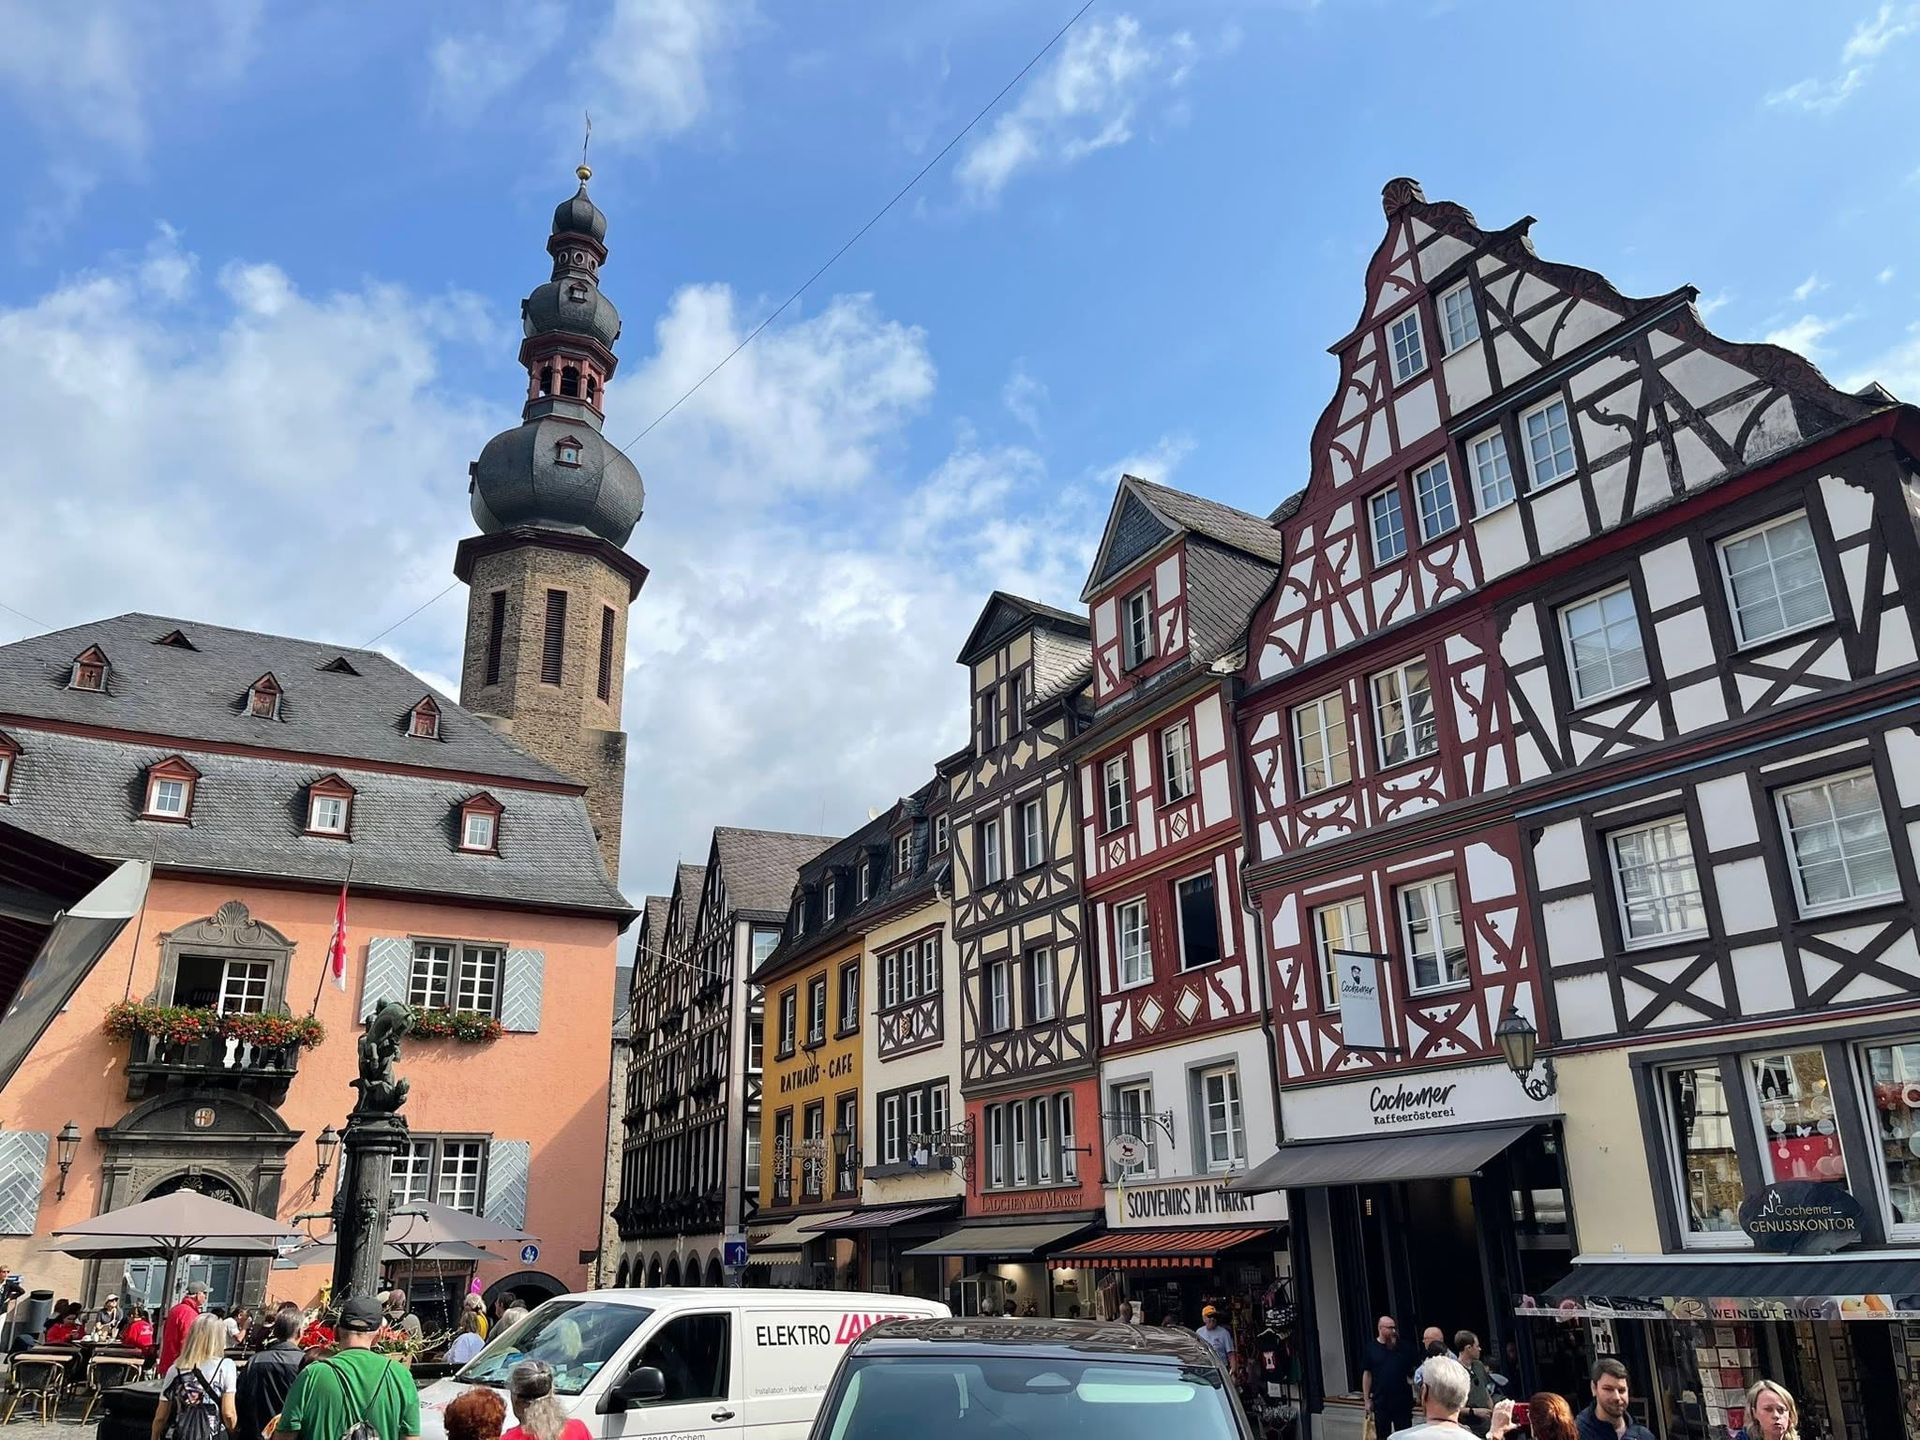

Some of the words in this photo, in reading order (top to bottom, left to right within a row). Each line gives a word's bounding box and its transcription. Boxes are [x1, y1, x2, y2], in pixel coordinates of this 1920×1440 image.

[1341, 980, 1375, 996] Cochemer
[780, 1064, 820, 1093] RATHAUS
[829, 1053, 852, 1079] CAFE
[1369, 1083, 1457, 1112] Cochemer
[1373, 1106, 1456, 1125] Kaffeerösterei
[1044, 1191, 1083, 1209] MARKT
[1127, 1187, 1191, 1219] SOUVENIRS
[1195, 1185, 1212, 1214] AM
[1775, 1203, 1832, 1216] Cochemer
[1749, 1217, 1856, 1233] GENUSSKONTOR
[1711, 1308, 1778, 1319] WEINGUT
[1783, 1308, 1821, 1319] RING
[756, 1324, 831, 1347] ELEKTRO
